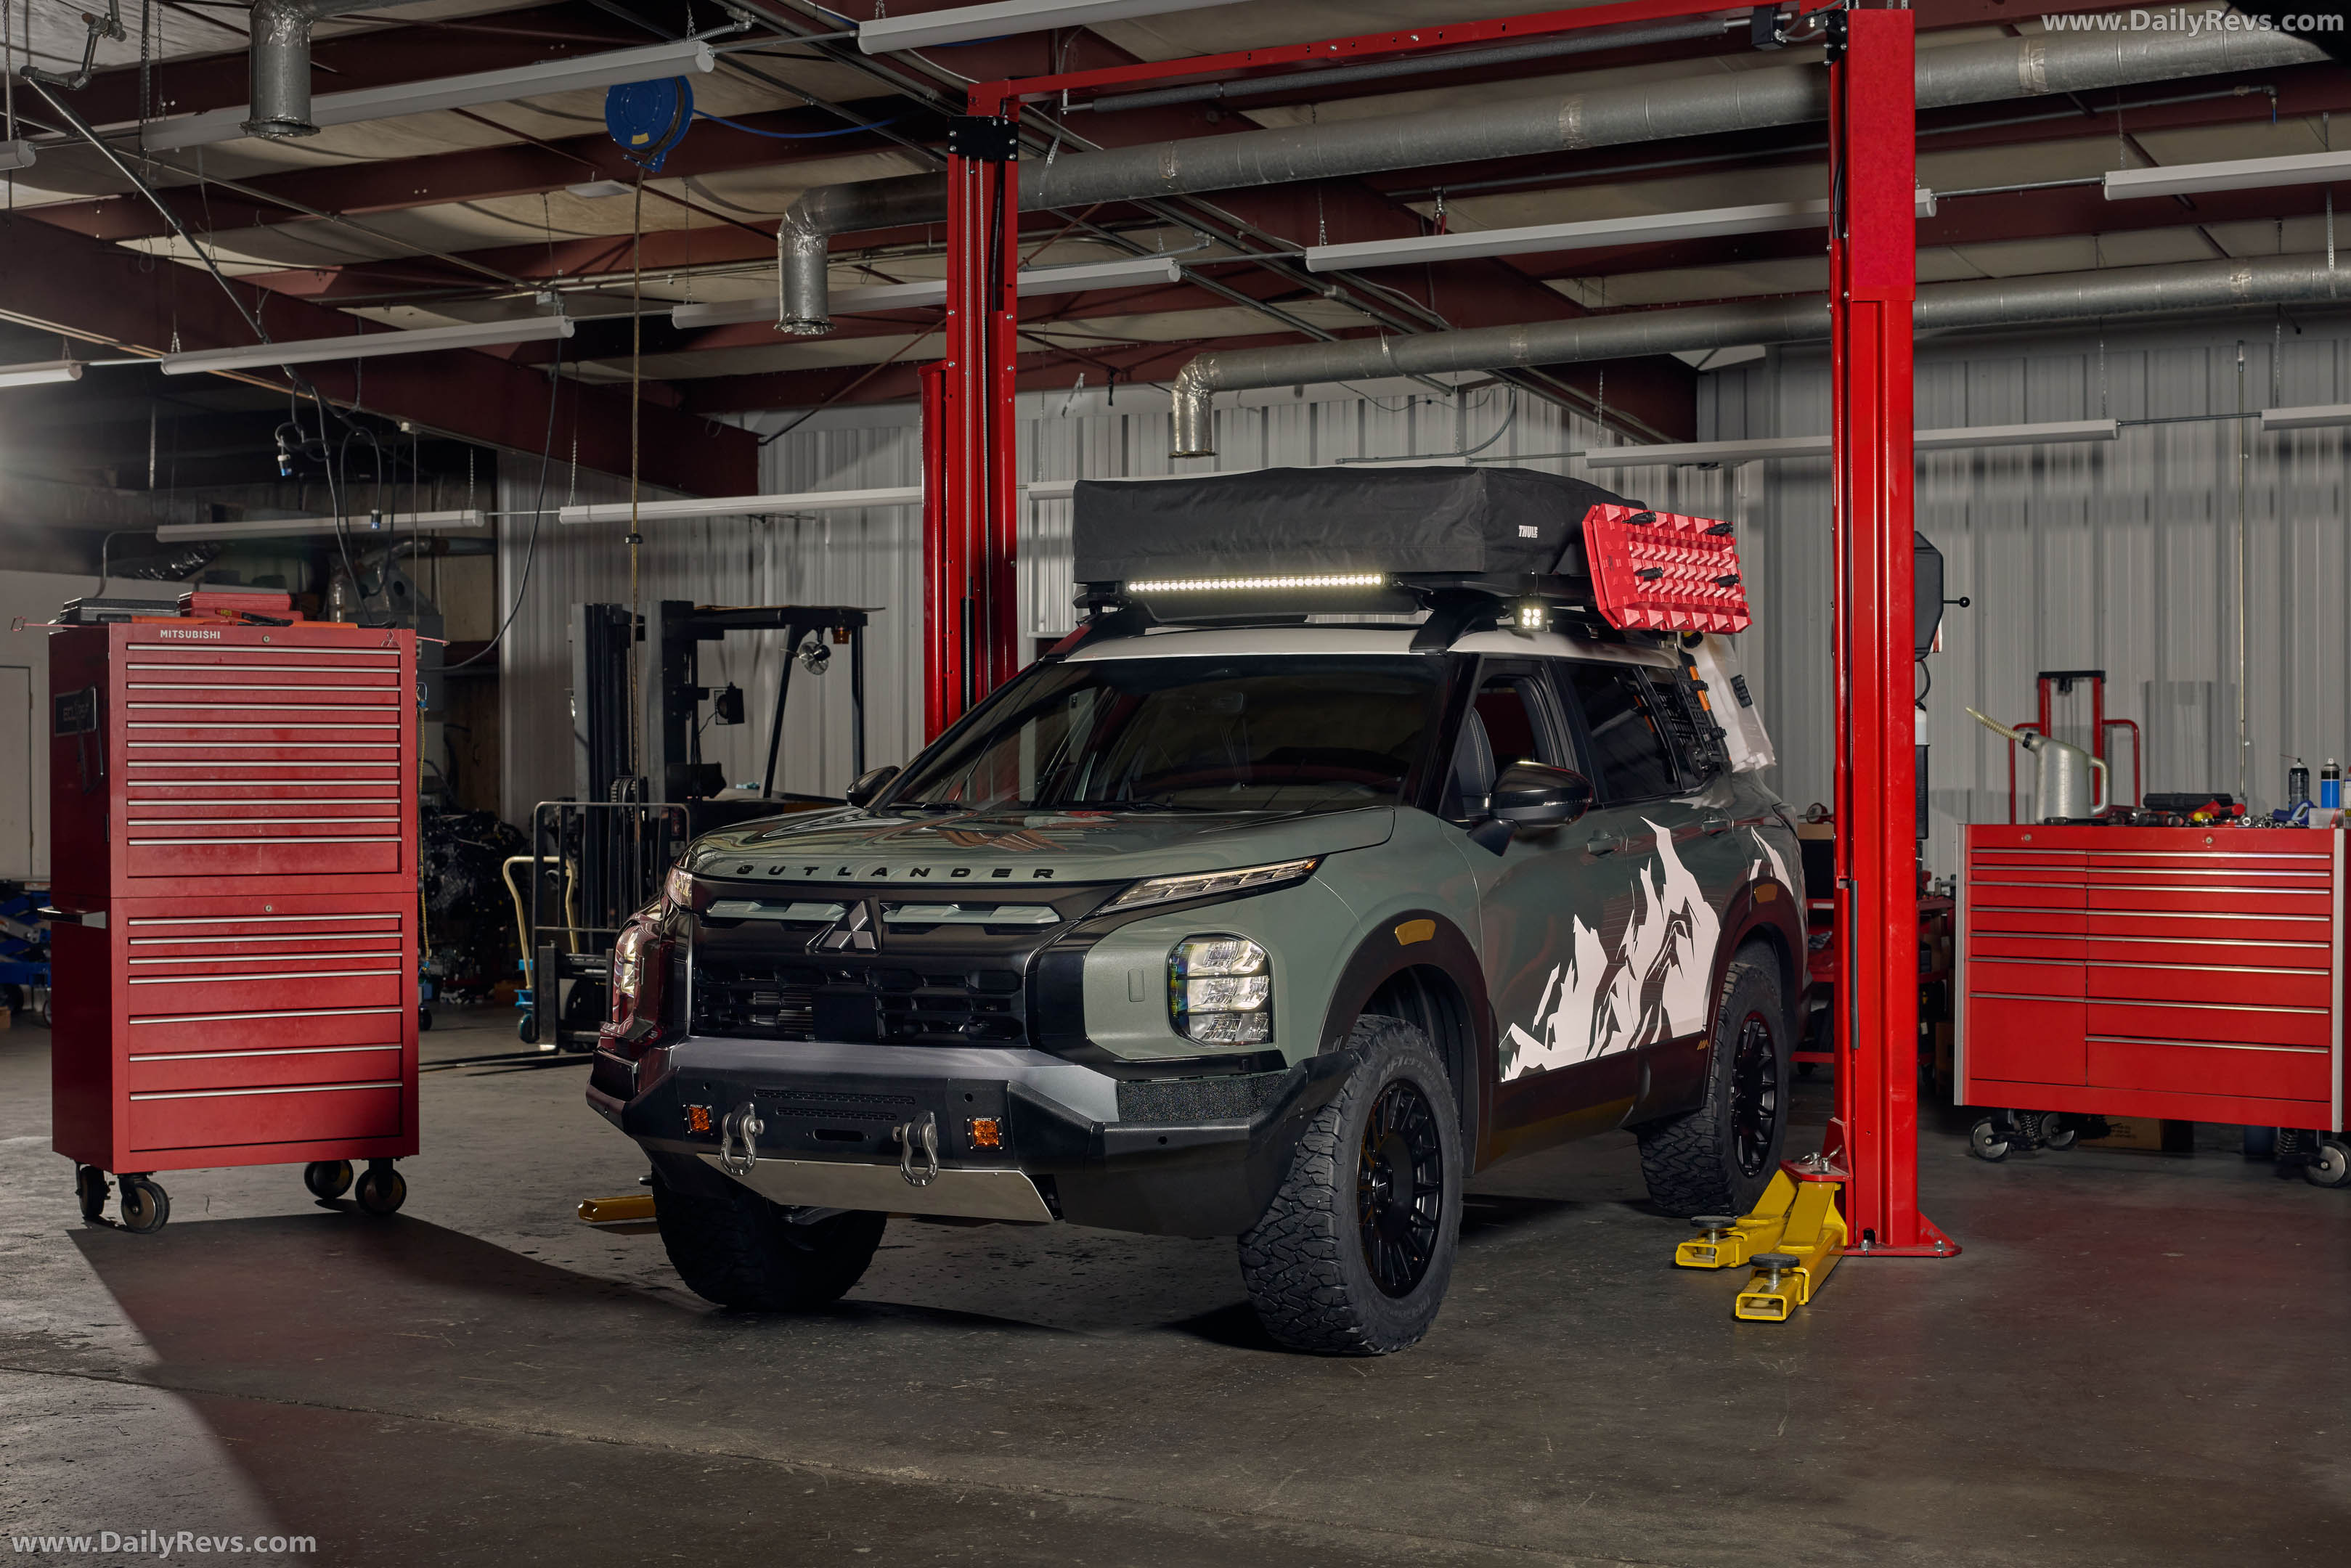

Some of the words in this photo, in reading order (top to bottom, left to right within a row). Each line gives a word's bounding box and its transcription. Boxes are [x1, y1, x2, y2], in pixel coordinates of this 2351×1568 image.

[1518, 525, 1538, 538] THULE
[160, 629, 221, 639] MITSUBISHI
[736, 865, 1054, 879] OUTLANDER
